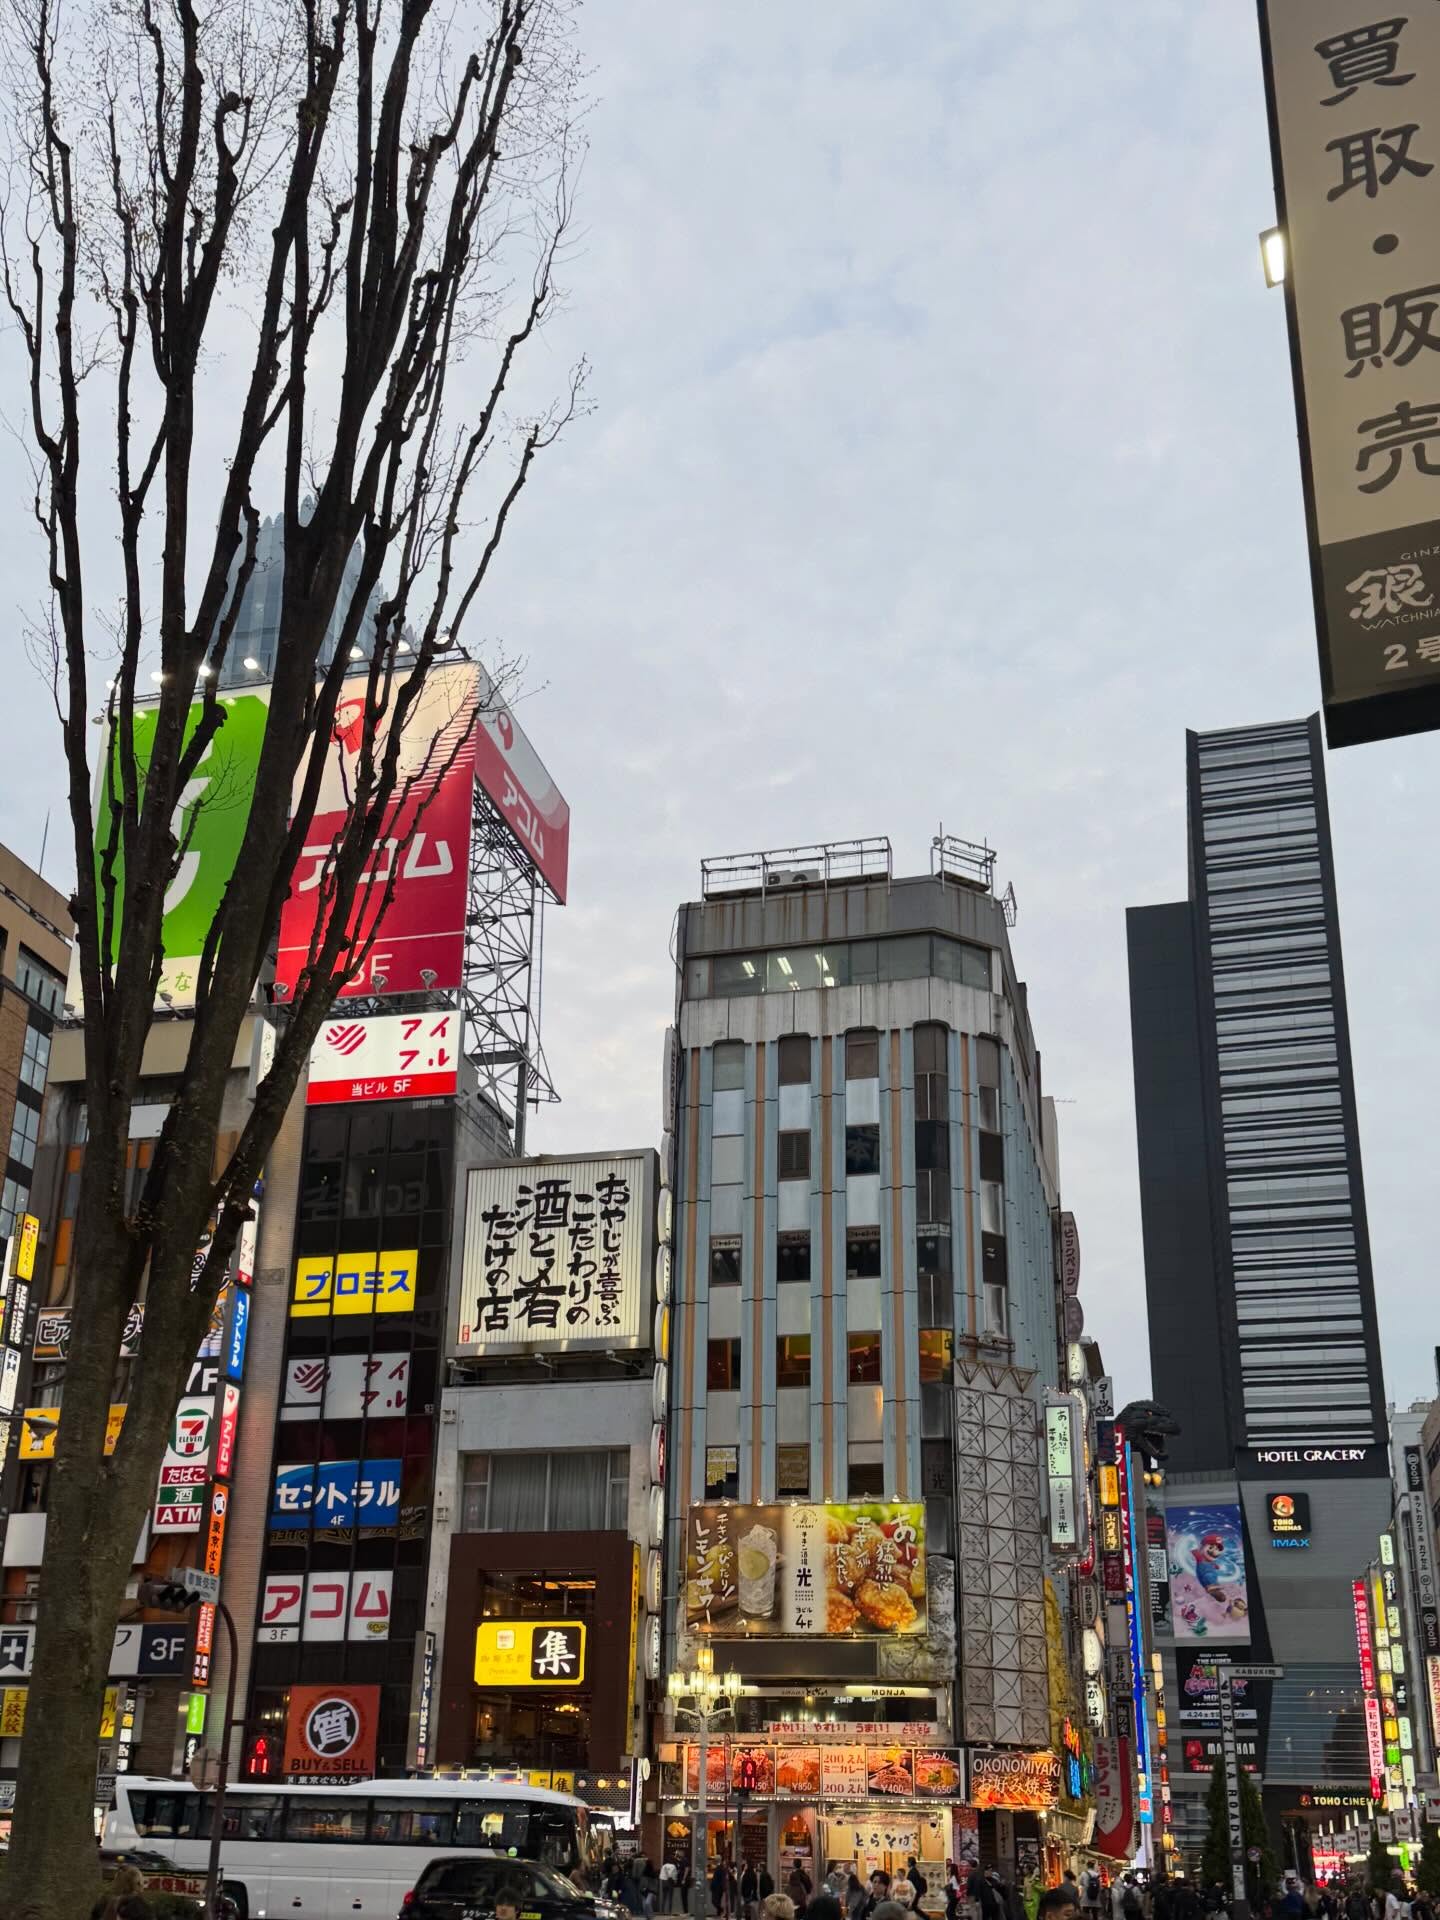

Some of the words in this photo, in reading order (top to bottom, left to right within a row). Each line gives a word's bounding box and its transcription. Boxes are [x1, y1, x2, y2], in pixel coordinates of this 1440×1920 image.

[1313, 17, 1440, 494] 買取・販売
[351, 1081, 388, 1097] 当ビル
[393, 1080, 412, 1094] 5F
[593, 1172, 631, 1326] おやじが喜ぶ
[566, 1193, 598, 1325] こだわりの
[472, 1204, 521, 1333] だけの店
[305, 1269, 410, 1298] プロミス
[1257, 1451, 1300, 1463] HOTEL
[1303, 1449, 1367, 1462] GRACERY
[167, 1467, 206, 1483] たばこ
[174, 1488, 193, 1503] 酒
[275, 1480, 401, 1510] セントラル
[160, 1507, 202, 1523] ATM
[330, 1514, 345, 1526] 4F
[1057, 1521, 1069, 1534] 光
[1272, 1538, 1310, 1548] IMAX
[695, 1518, 715, 1625] レモンサワー
[796, 1567, 813, 1587] 光
[263, 1582, 390, 1621] アコム
[795, 1614, 813, 1629] 4F
[270, 1629, 288, 1640] 3F
[150, 1637, 186, 1661] 3F
[534, 1630, 576, 1675] 集
[871, 1689, 906, 1697] MONJA
[823, 1754, 844, 1764] 200
[848, 1754, 865, 1764] えん
[915, 1751, 950, 1761] らーめん
[290, 1759, 320, 1772] BUY
[333, 1758, 369, 1771] SELL
[823, 1765, 865, 1774] ミニカレー
[973, 1757, 1062, 1778] OKONOMIYAKI
[823, 1784, 845, 1794] 200
[848, 1784, 866, 1794] えん
[978, 1774, 1053, 1796] お好み焼き
[1313, 1796, 1341, 1806] TOHO
